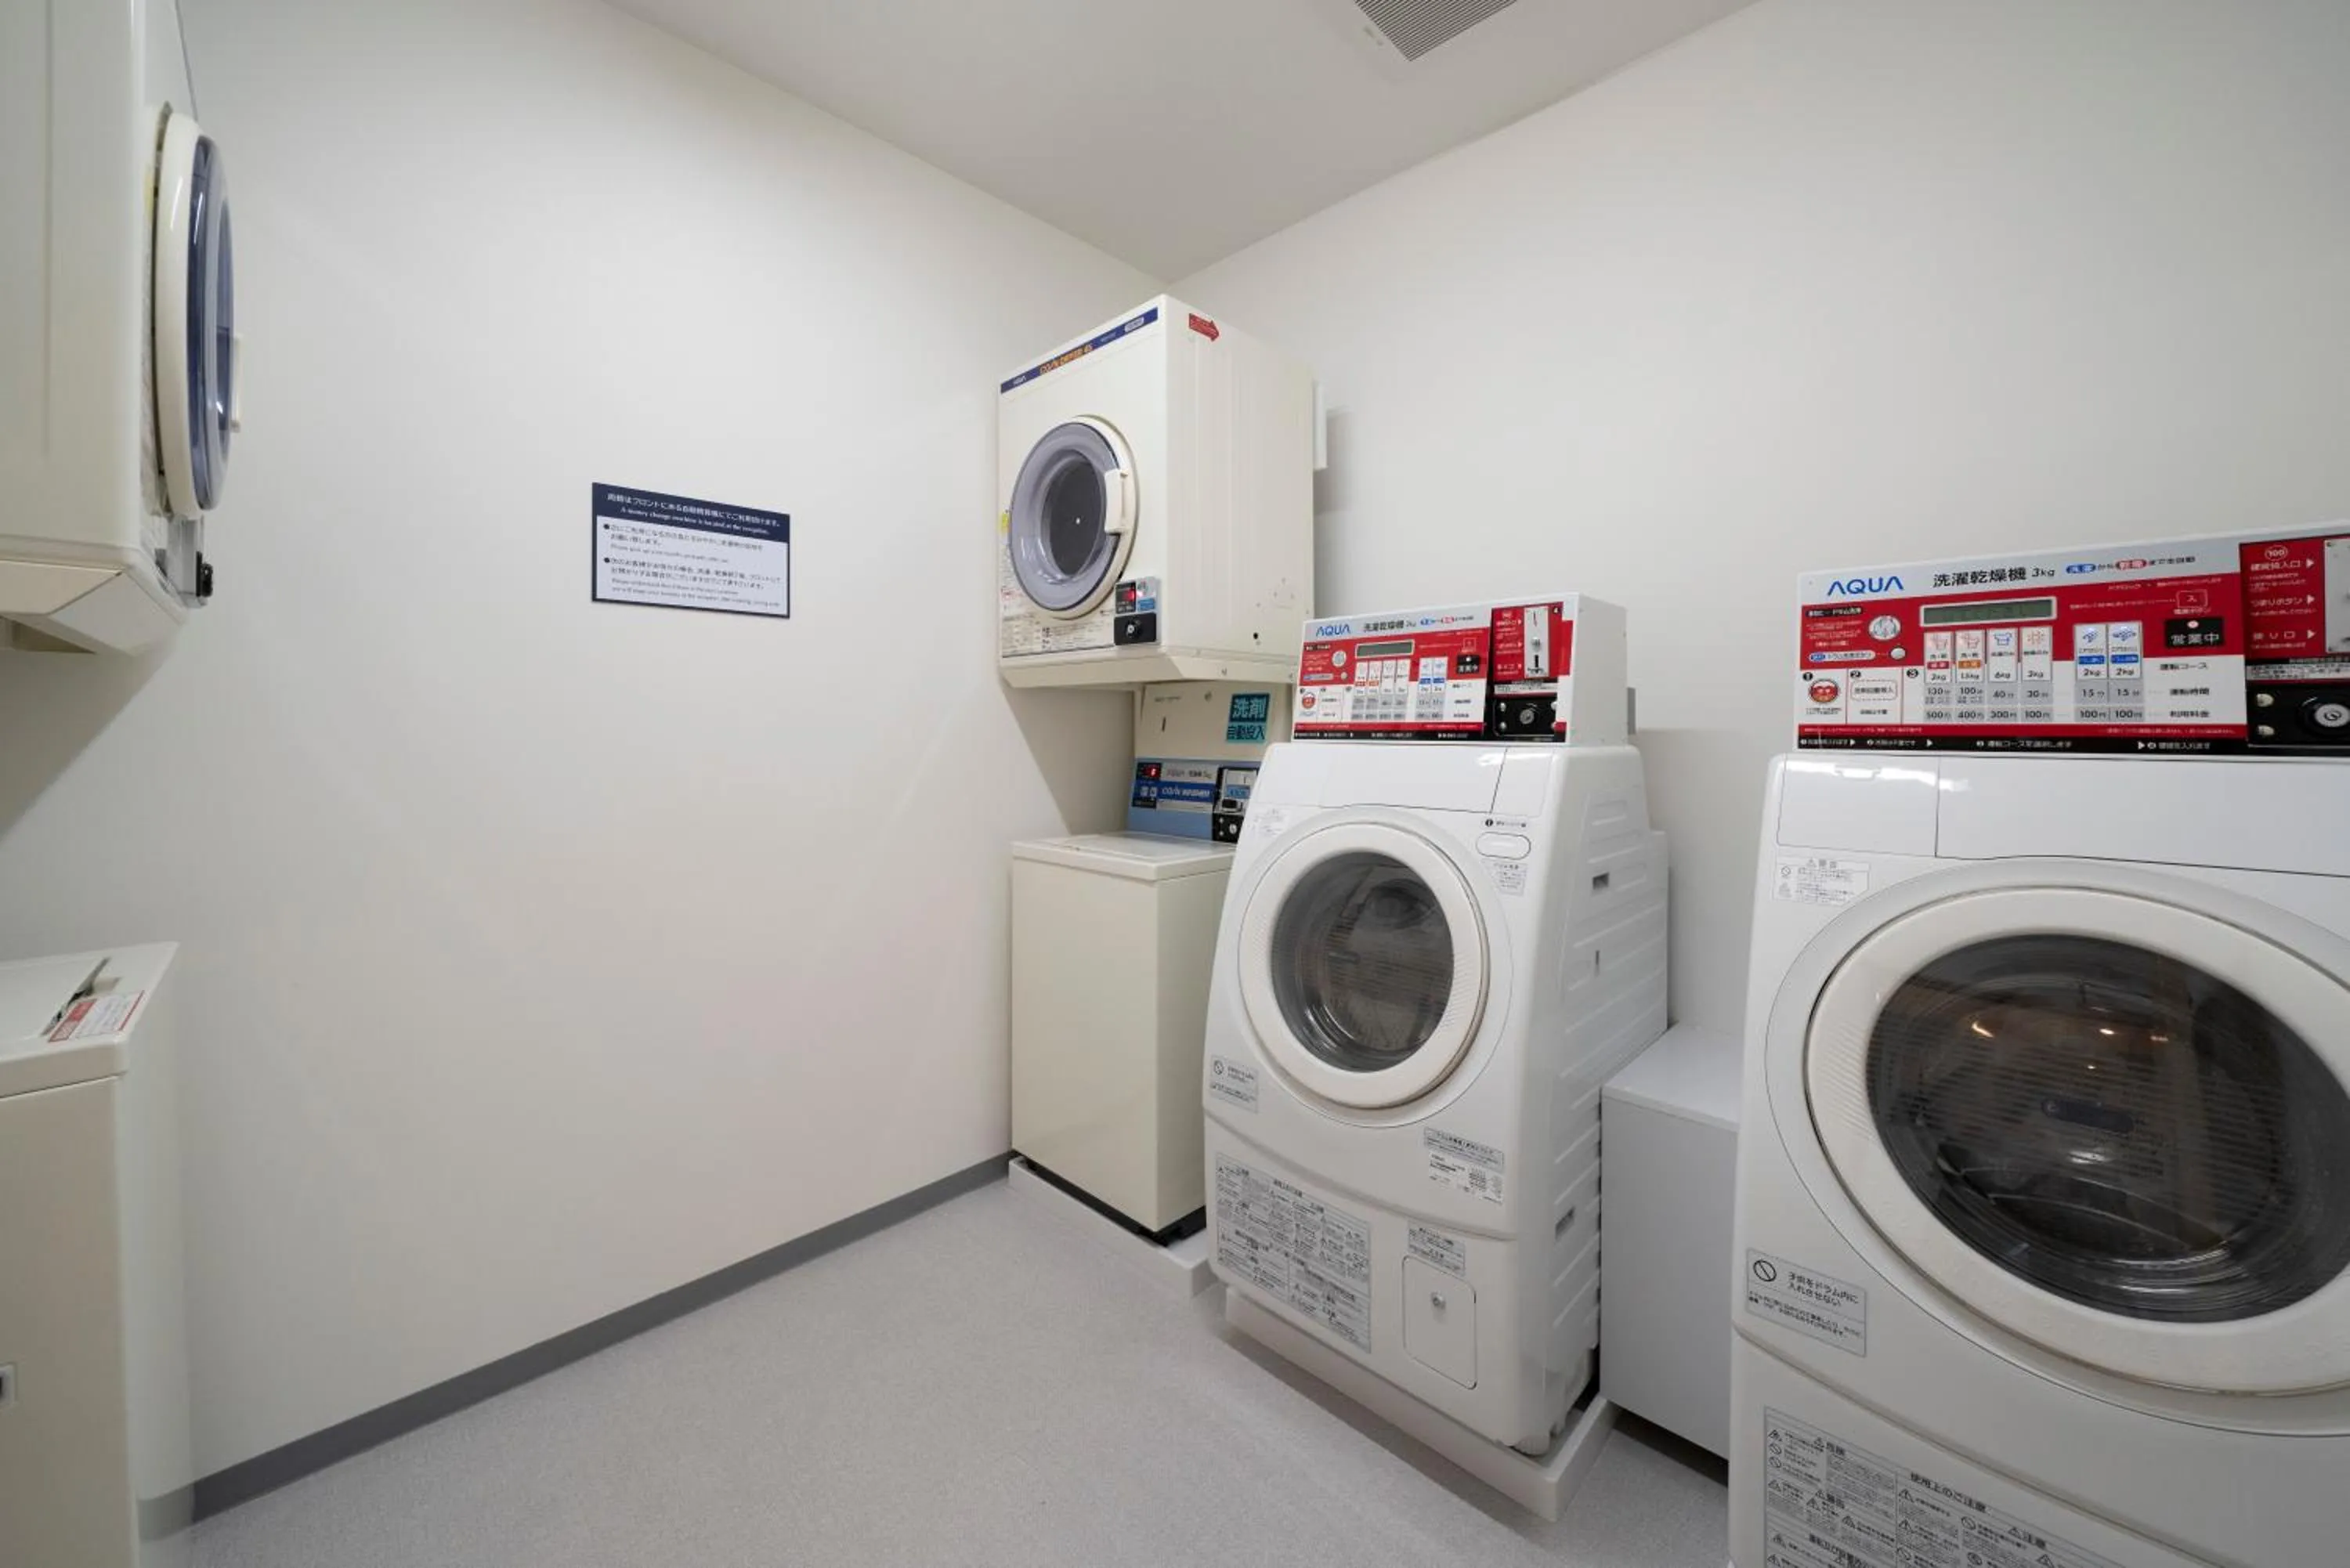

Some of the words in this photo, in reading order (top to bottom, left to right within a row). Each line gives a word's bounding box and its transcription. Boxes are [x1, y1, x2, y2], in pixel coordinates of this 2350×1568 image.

[1828, 576, 1904, 596] AQUA
[1932, 567, 2026, 587] 洗濯乾燥機
[2031, 567, 2055, 578] 3kg
[1316, 623, 1350, 637] AQUA
[2171, 632, 2219, 646] 営業中
[1232, 698, 1267, 718] 洗剤
[1227, 724, 1265, 740] 自動投入
